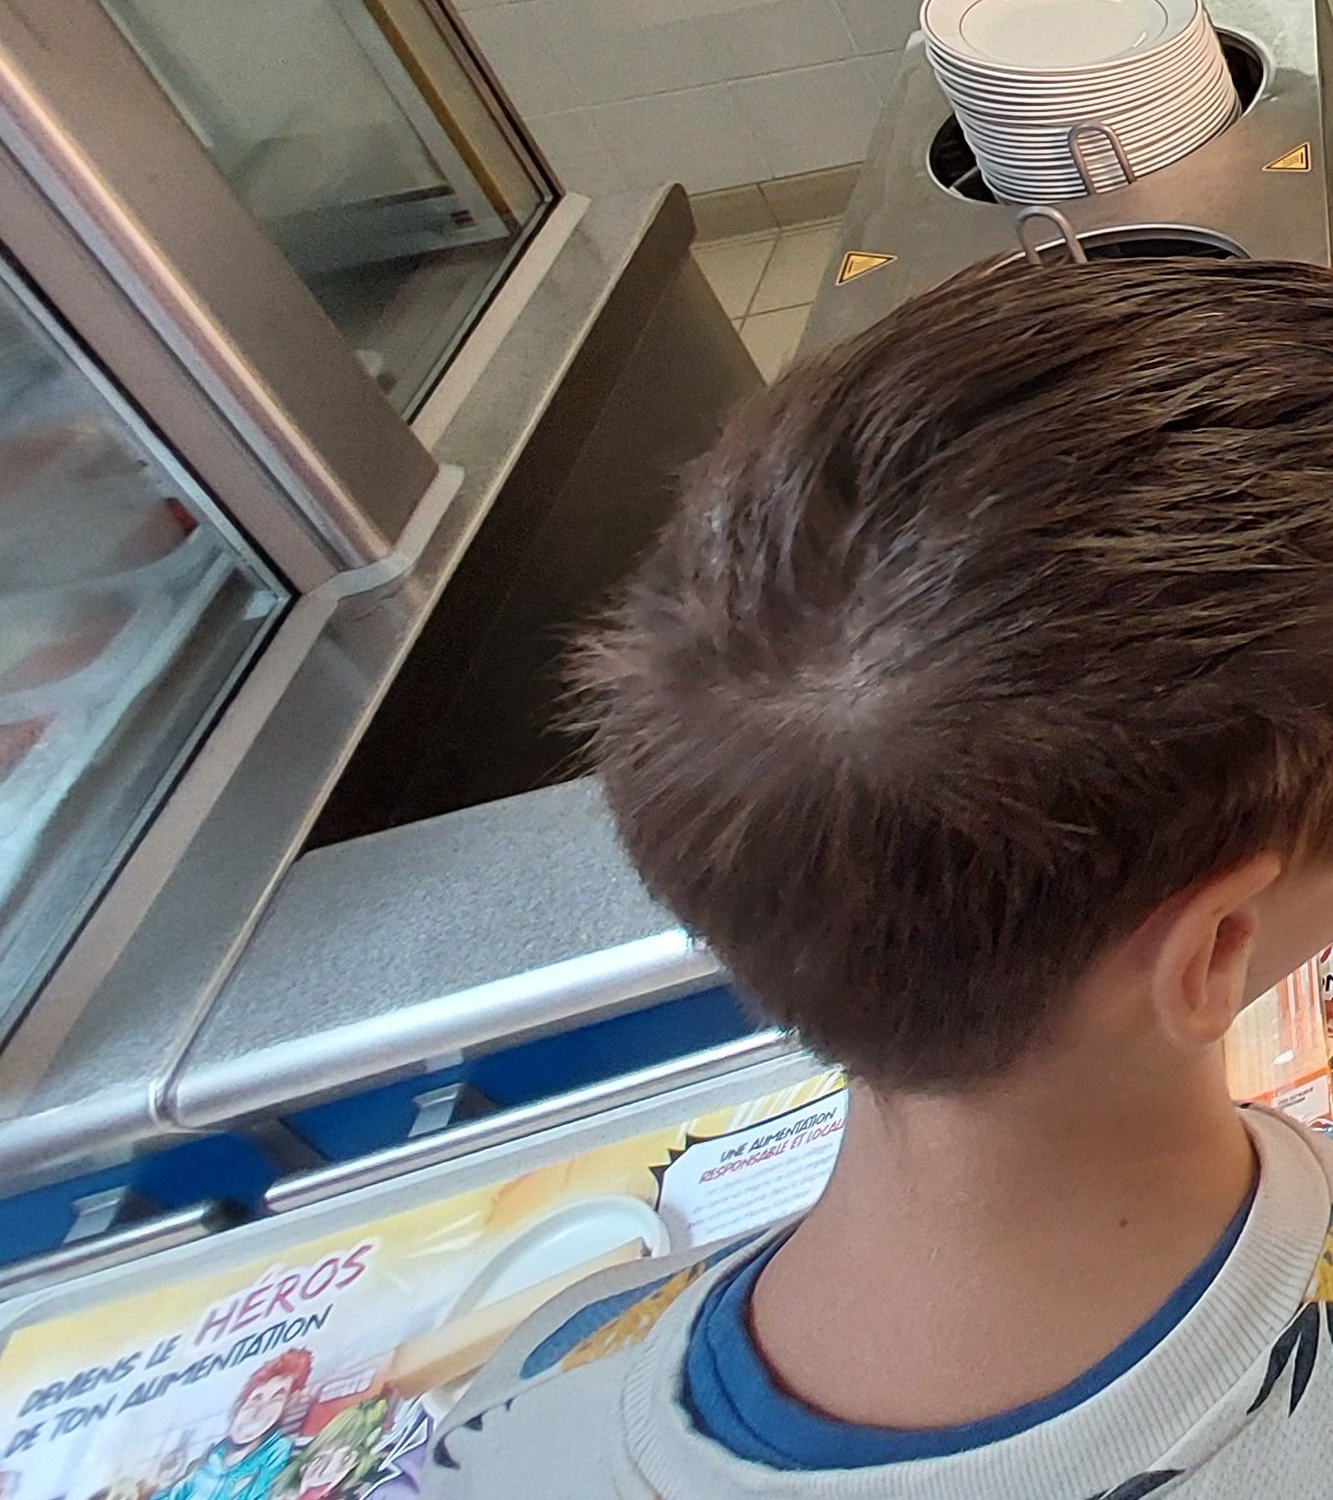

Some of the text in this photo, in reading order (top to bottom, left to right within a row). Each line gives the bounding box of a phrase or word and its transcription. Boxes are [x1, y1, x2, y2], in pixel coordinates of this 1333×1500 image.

[699, 1145, 789, 1184] RESPONSABLE
[790, 1135, 806, 1150] ET
[720, 1107, 837, 1163] UNE ALIMENTATION
[4, 1303, 334, 1460] DE TON ALIMENTATION
[17, 1243, 374, 1418] DEVIENS LE HÉROS
